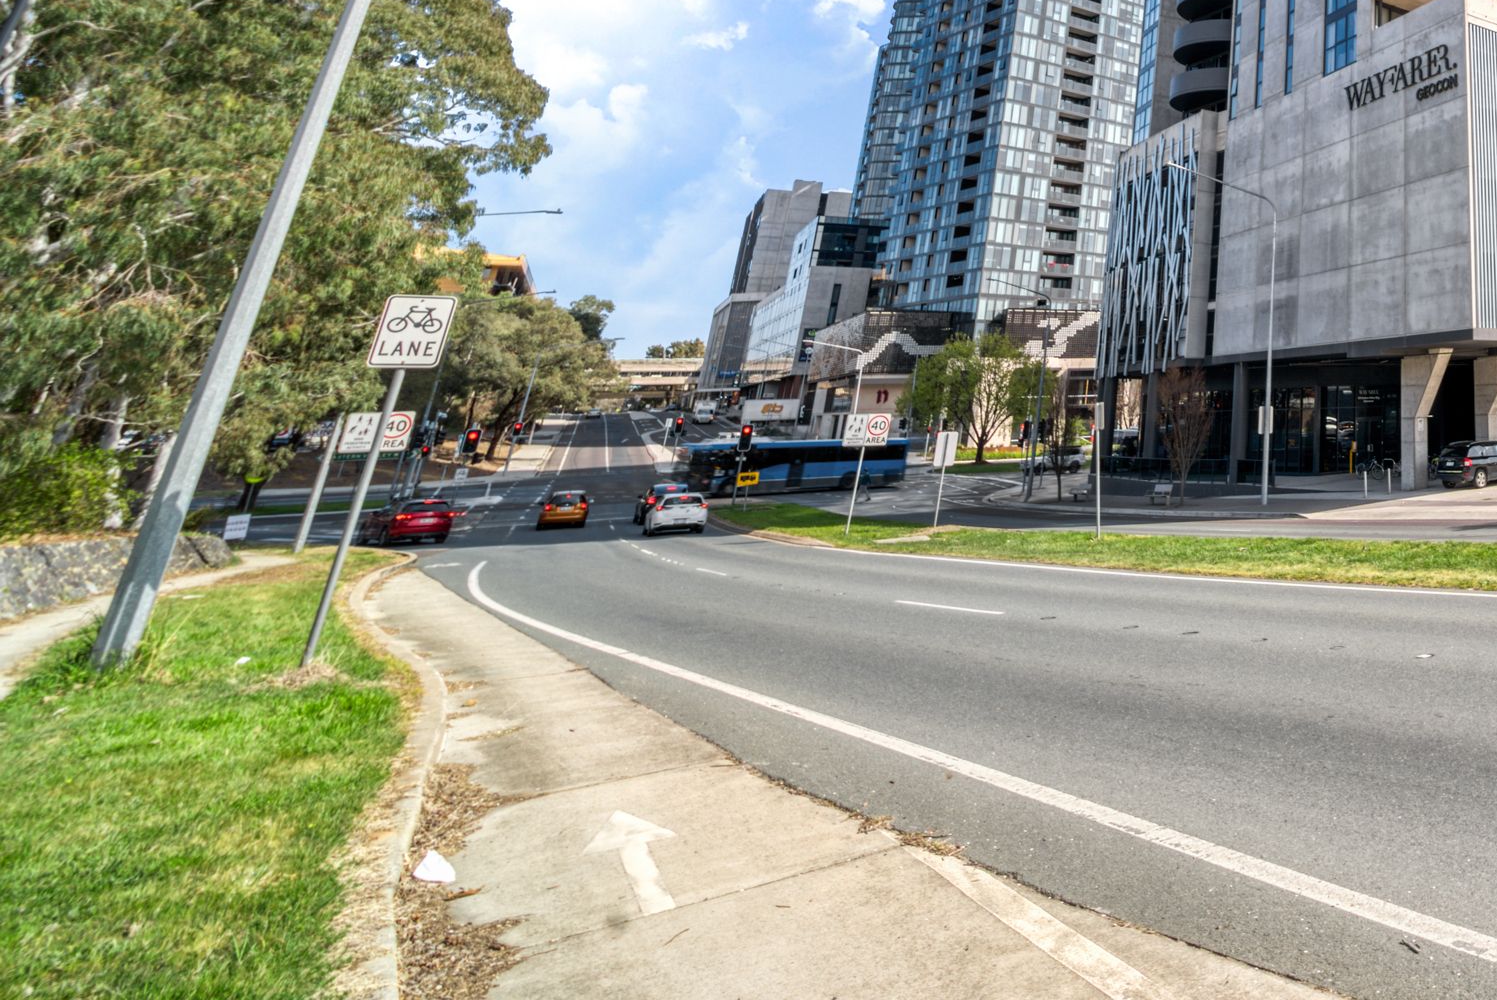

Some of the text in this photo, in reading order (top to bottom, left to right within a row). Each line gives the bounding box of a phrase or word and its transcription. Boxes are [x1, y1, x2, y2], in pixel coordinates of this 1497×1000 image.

[1416, 74, 1458, 101] GEOCON
[378, 341, 436, 356] LANE
[386, 420, 407, 432] 40
[871, 420, 887, 431] 40
[382, 440, 404, 449] REA
[865, 436, 886, 444] AREA
